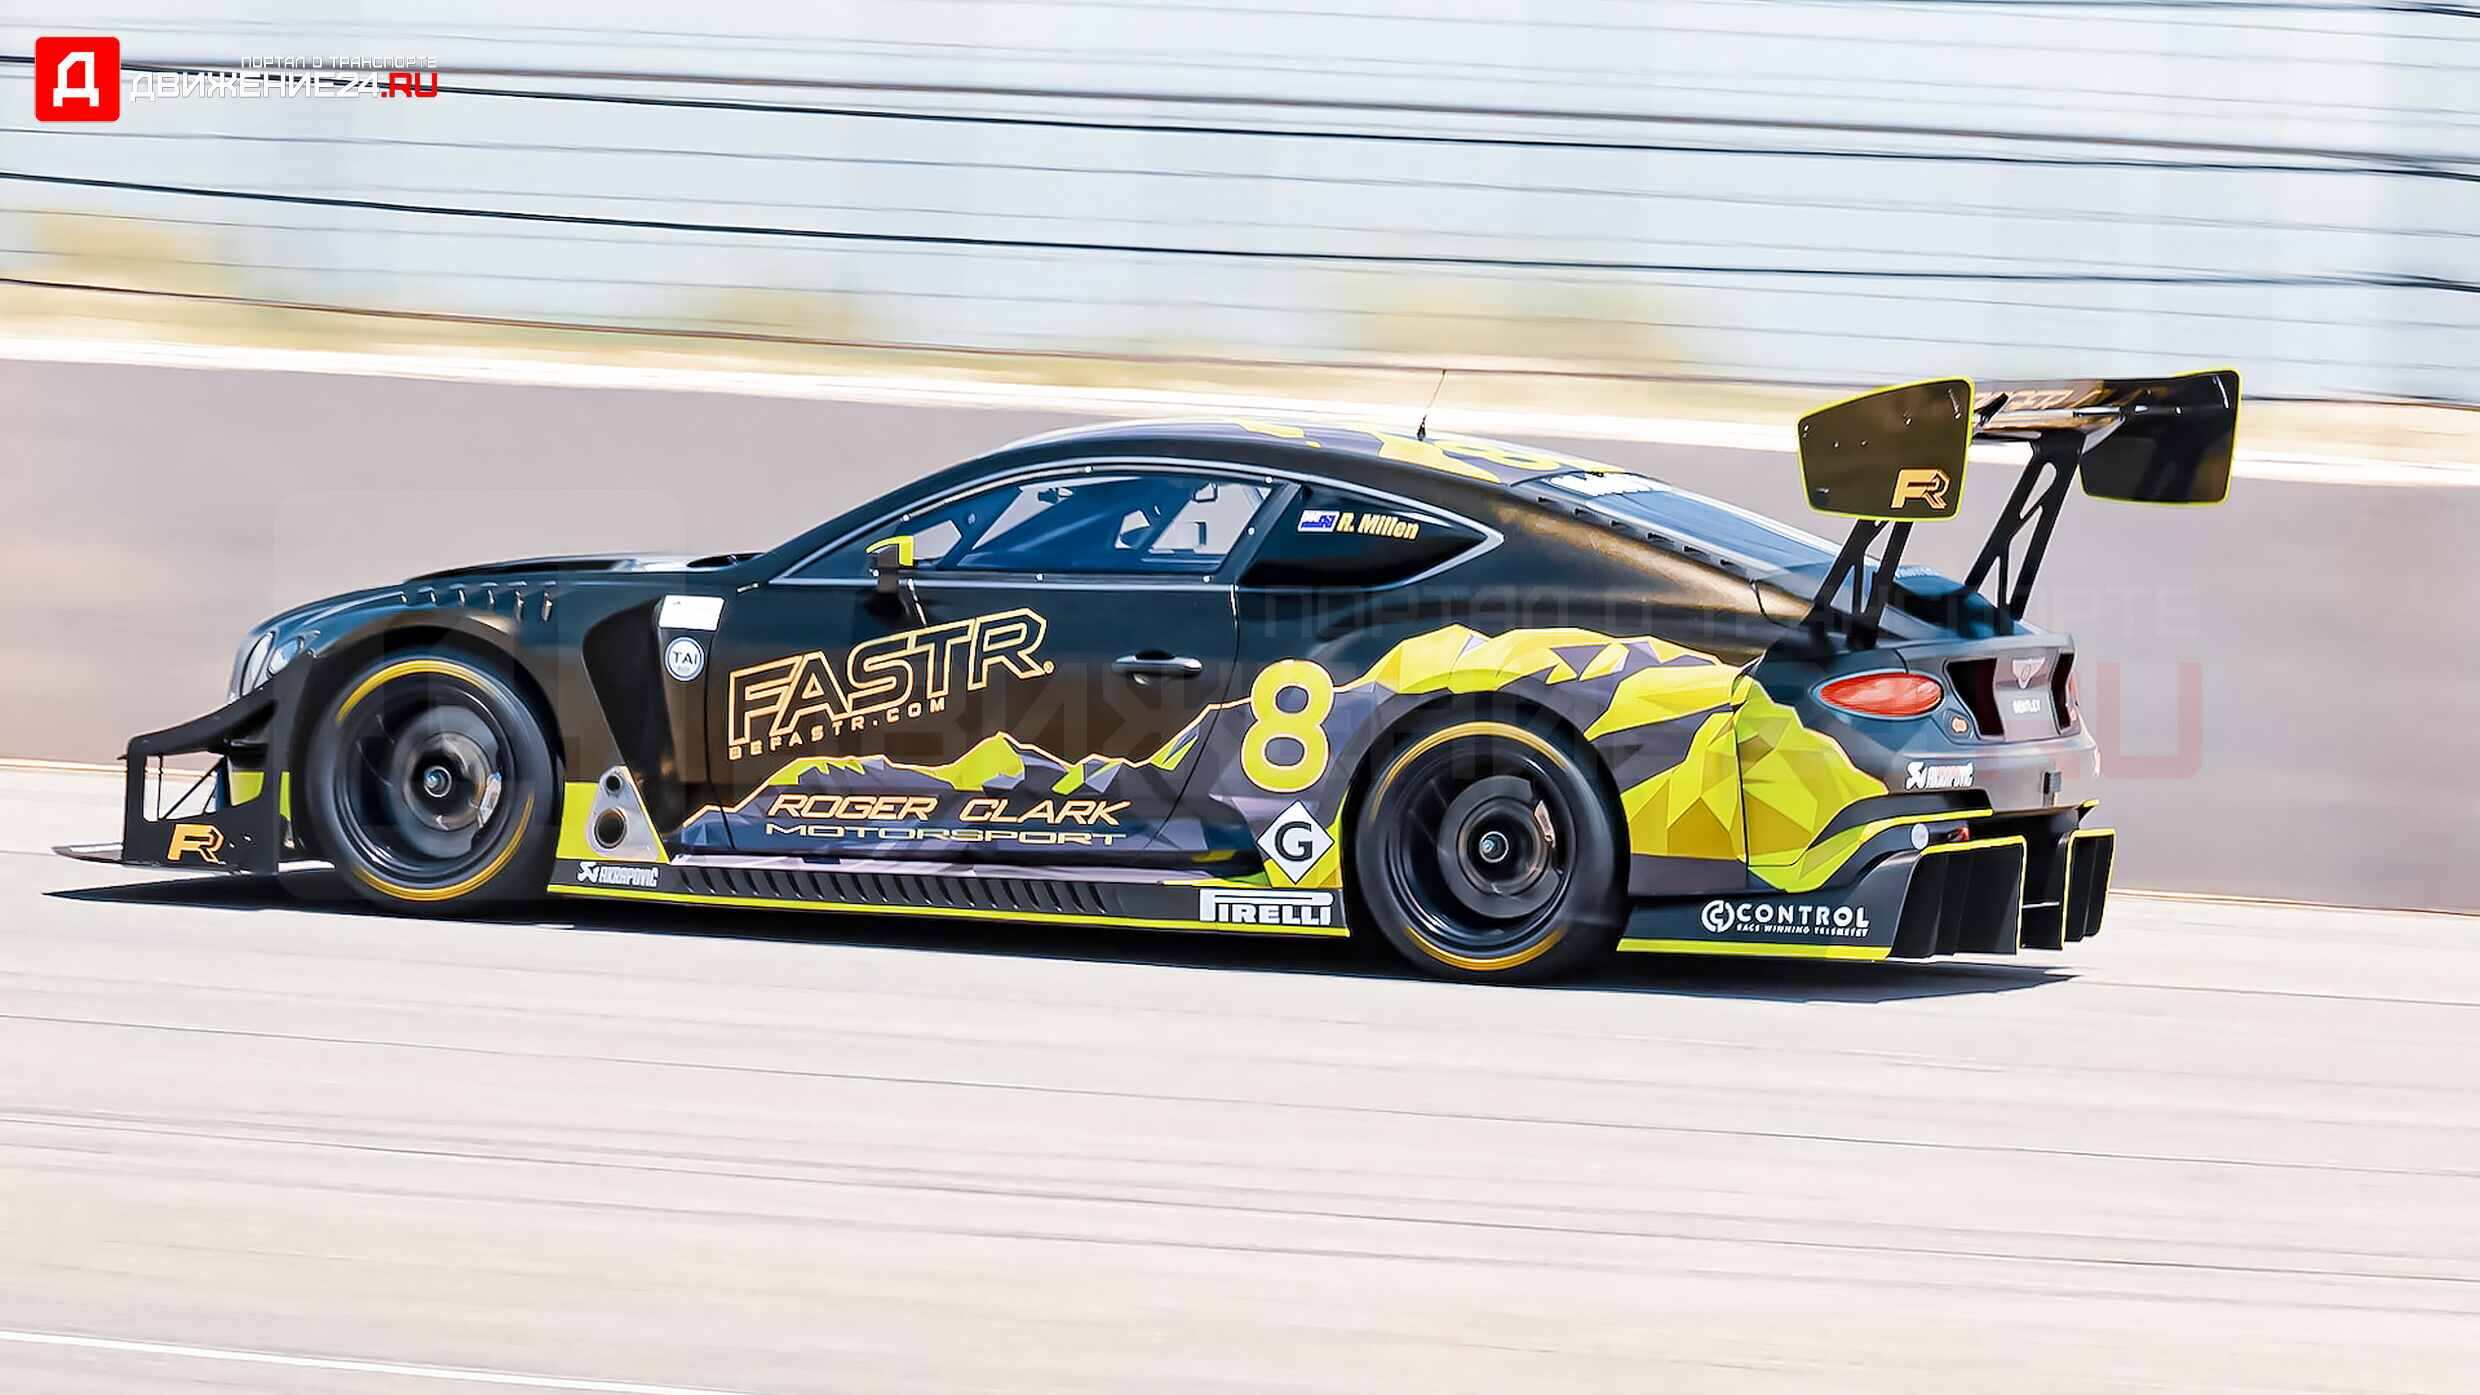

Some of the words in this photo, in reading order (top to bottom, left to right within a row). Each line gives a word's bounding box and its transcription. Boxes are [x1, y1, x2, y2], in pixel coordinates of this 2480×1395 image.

[1337, 512, 1354, 532] R.
[673, 651, 698, 665] TAI
[1240, 658, 1335, 794] 8
[767, 793, 939, 822] ROGER
[959, 798, 1132, 826] CLARK
[765, 823, 1127, 846] MOTORSPORT
[1274, 820, 1313, 862] G
[1200, 888, 1334, 926] PIRELLI
[1736, 903, 1870, 929] CONTROL
